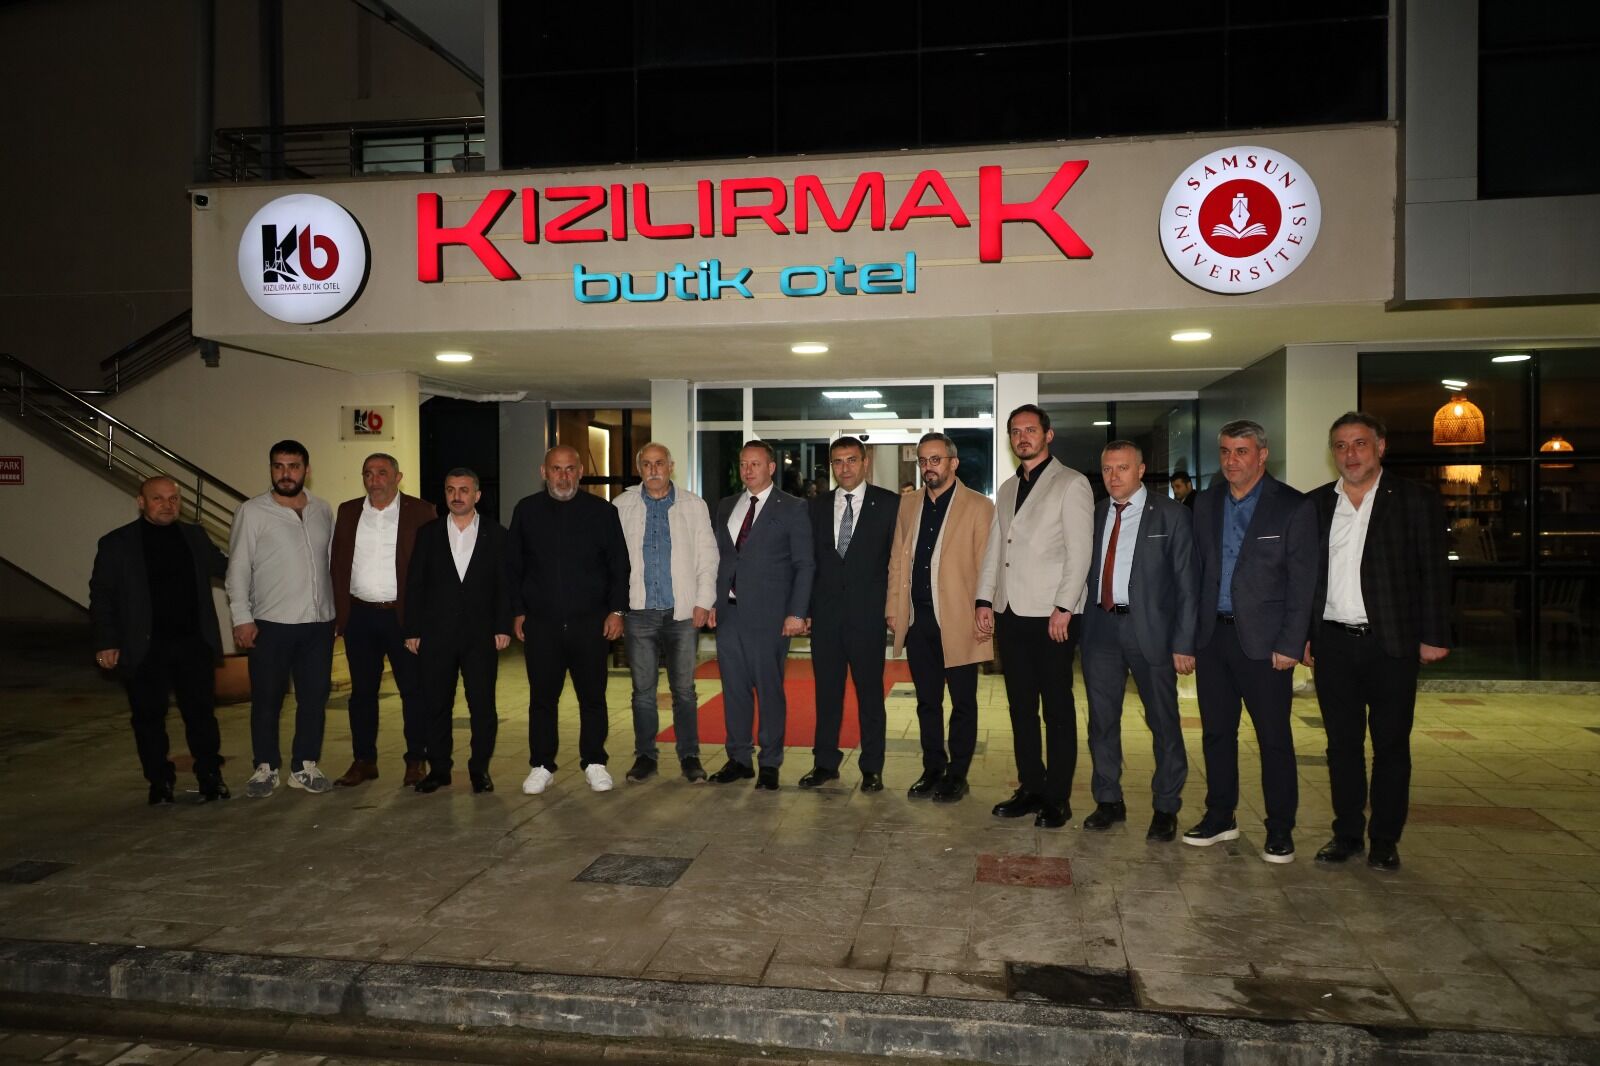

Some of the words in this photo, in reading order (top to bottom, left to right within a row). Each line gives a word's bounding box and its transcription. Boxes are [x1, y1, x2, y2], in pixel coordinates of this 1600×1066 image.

[1187, 154, 1297, 190] SAMSUN
[417, 160, 1094, 283] KIZILIRMAK
[1174, 202, 1308, 282] ÜNİVERSİTESİ
[263, 283, 301, 293] KIZILIRMAK
[323, 282, 341, 290] OTEL
[573, 258, 754, 304] butik
[779, 251, 917, 298] otel
